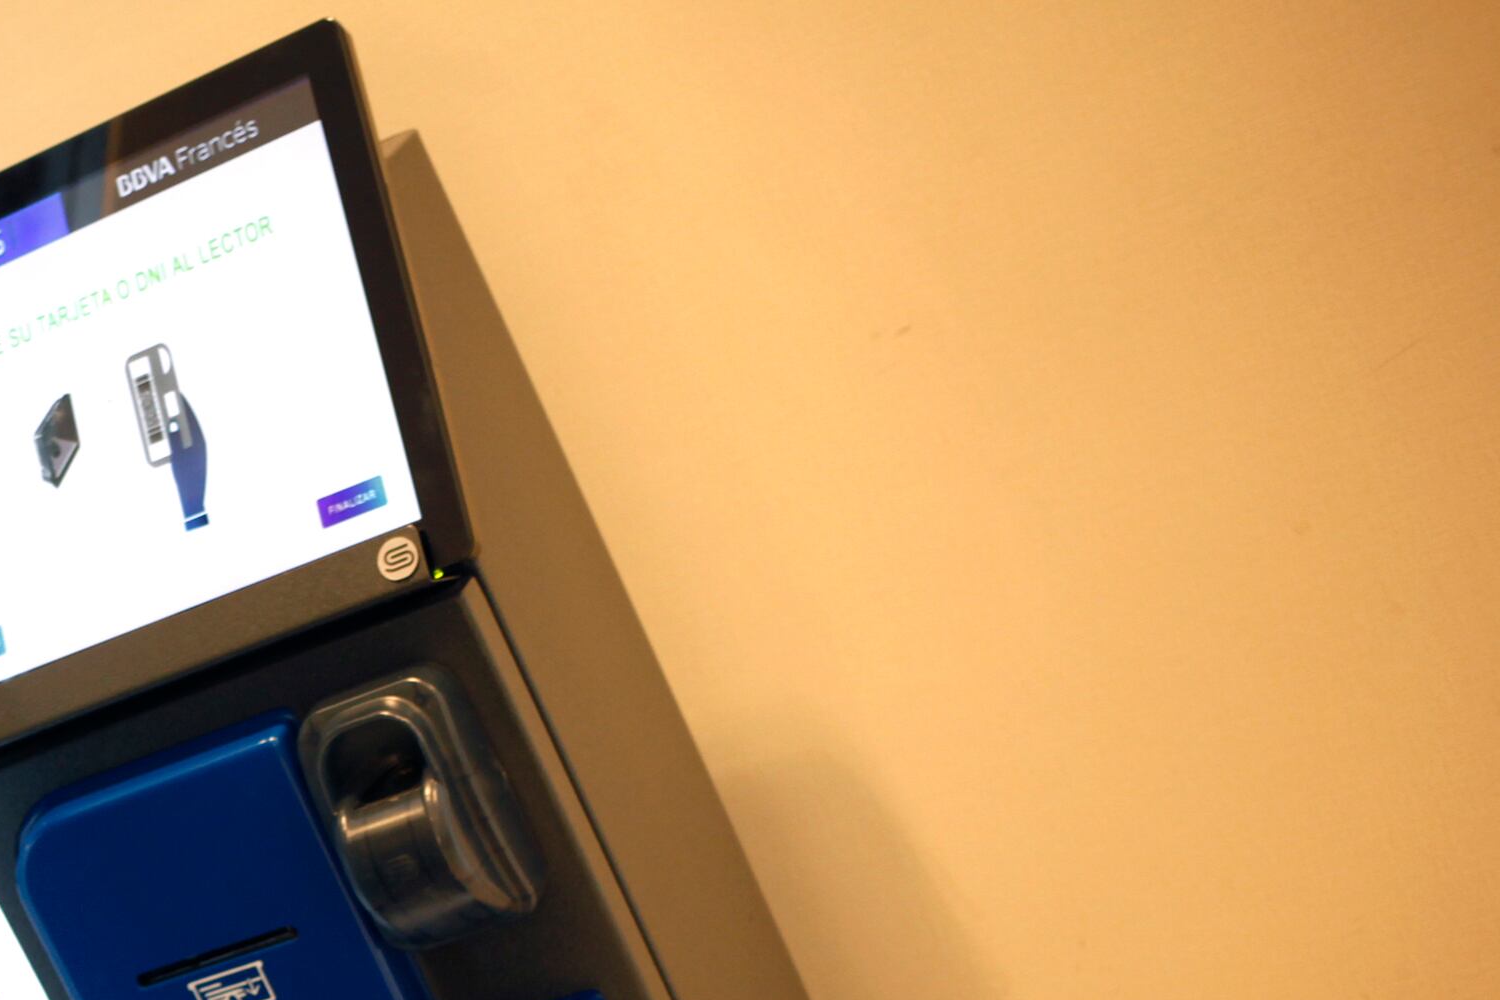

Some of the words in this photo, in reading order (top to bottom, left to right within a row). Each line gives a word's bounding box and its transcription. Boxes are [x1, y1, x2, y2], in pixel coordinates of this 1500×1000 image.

[116, 156, 176, 197] BBVA
[175, 120, 259, 169] Francés
[8, 321, 33, 348] SU
[36, 287, 113, 331] TARJETA
[116, 279, 131, 300] O
[135, 262, 167, 292] DNI
[172, 252, 195, 278] AL
[198, 215, 274, 265] LECTOR
